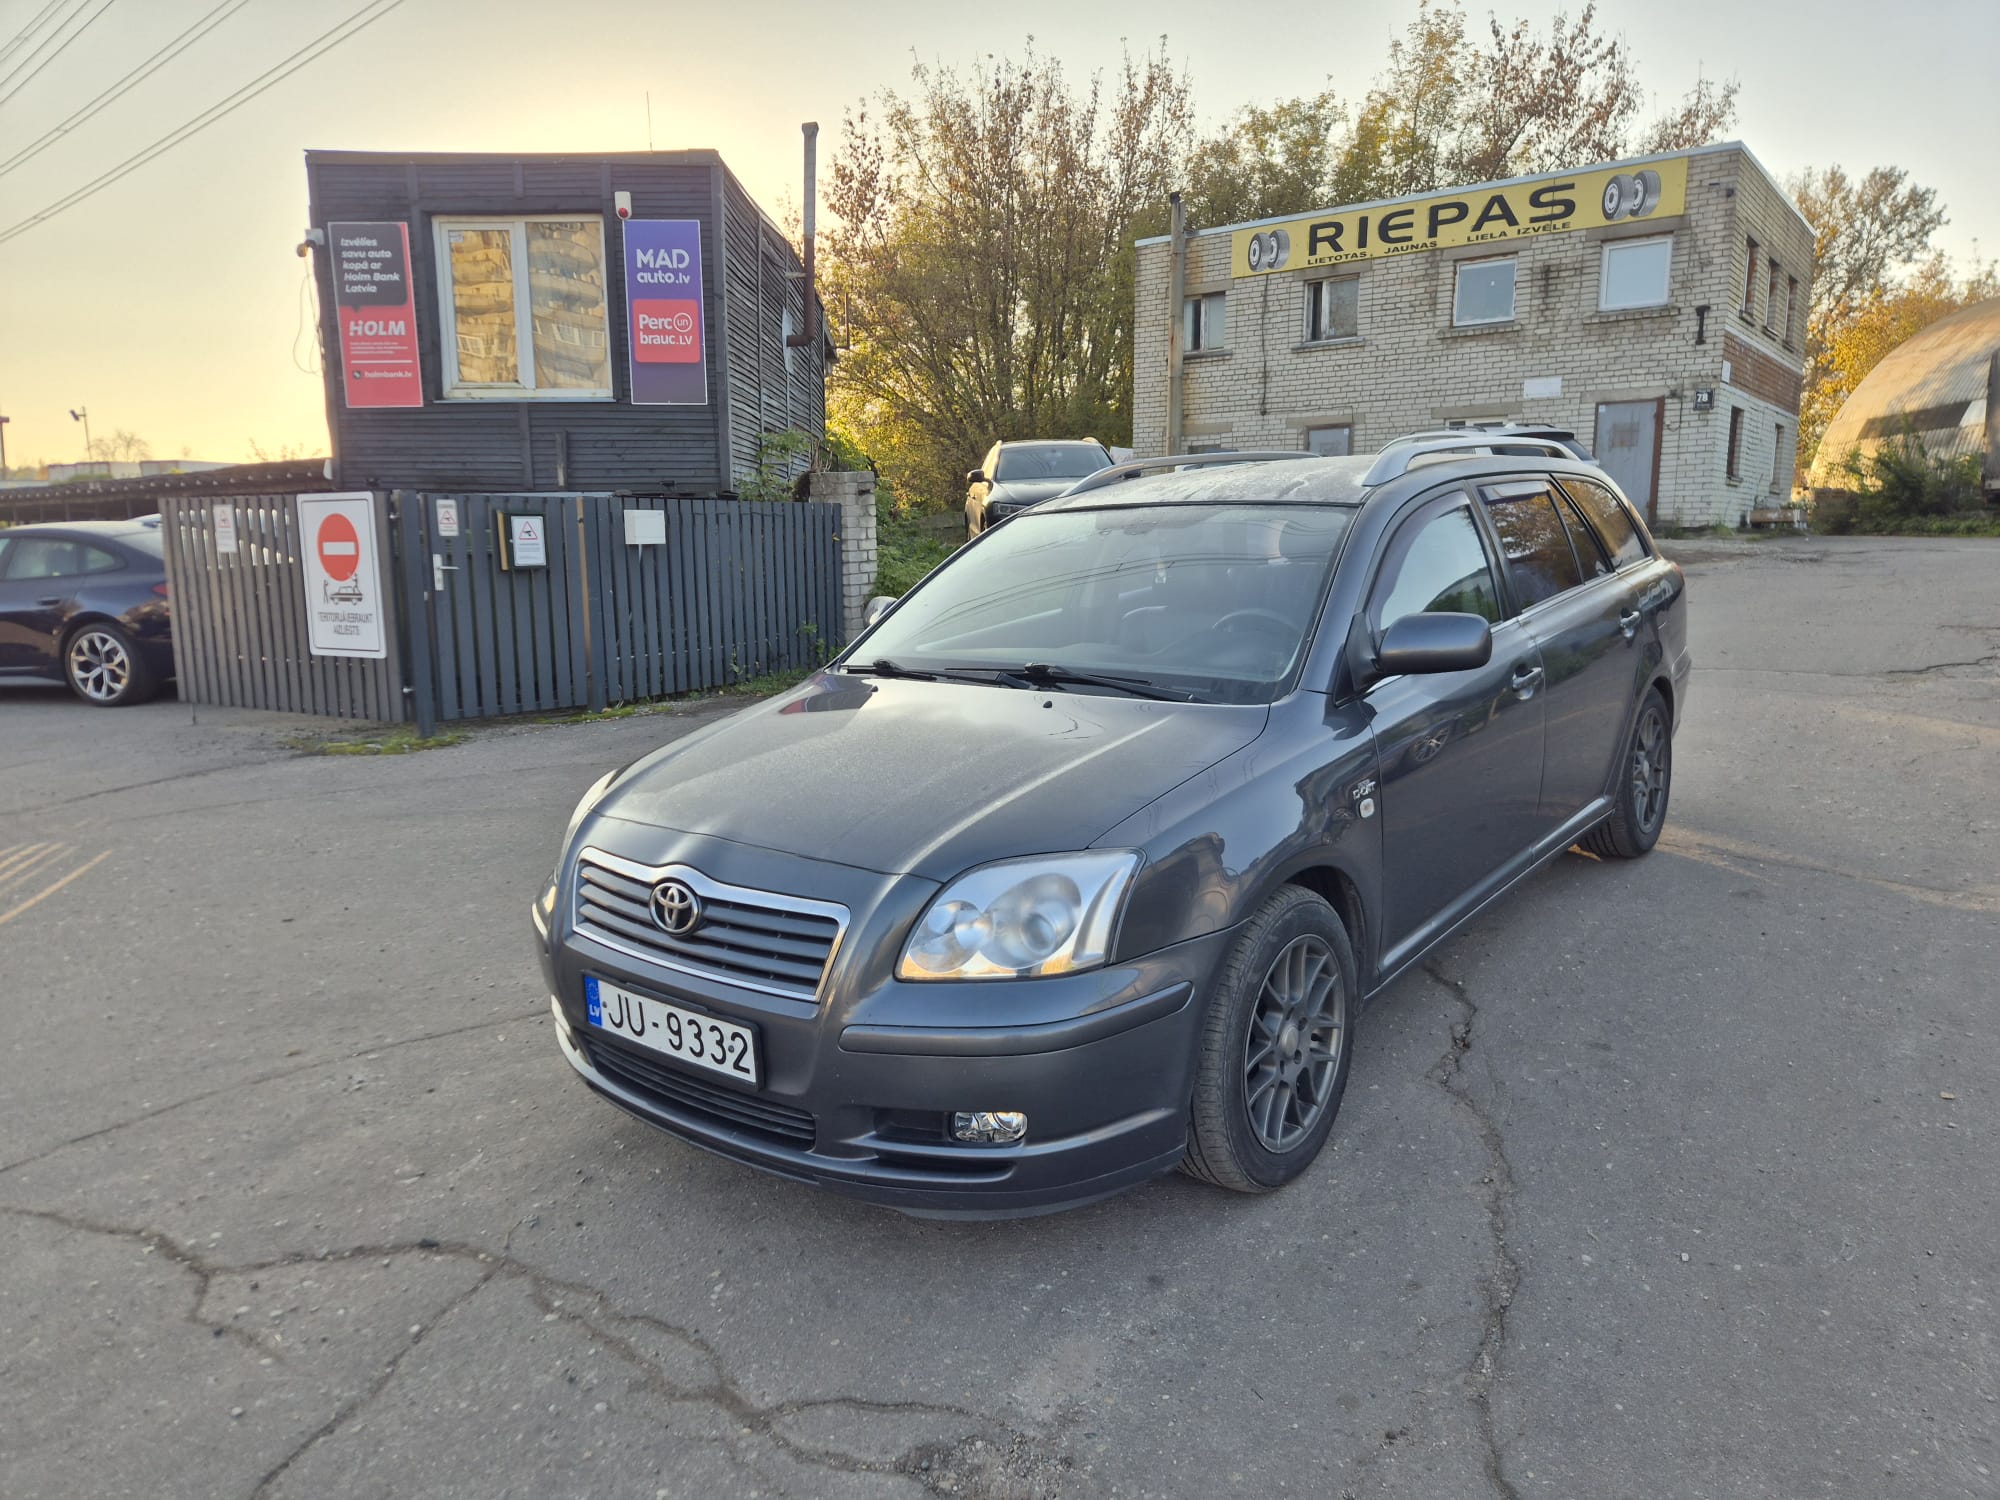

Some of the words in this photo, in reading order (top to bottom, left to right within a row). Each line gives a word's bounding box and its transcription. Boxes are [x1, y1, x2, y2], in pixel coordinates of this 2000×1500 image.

[1308, 183, 1576, 256] RIEPAS
[341, 250, 366, 258] savu
[367, 250, 392, 258] auto
[1307, 251, 1367, 265] LIETOTAS
[1384, 241, 1437, 254] JAUNAS
[1467, 231, 1507, 242] LIELA
[636, 248, 690, 269] MAD
[344, 272, 371, 280] Holm
[373, 272, 400, 280] Bank
[637, 270, 691, 284] auto.lv
[345, 283, 377, 292] Latvia
[349, 320, 406, 336] HOLM
[639, 314, 673, 330] Perc
[640, 331, 693, 345] brauc.LV
[589, 1004, 600, 1017] LV
[608, 993, 750, 1074] JU-9332
